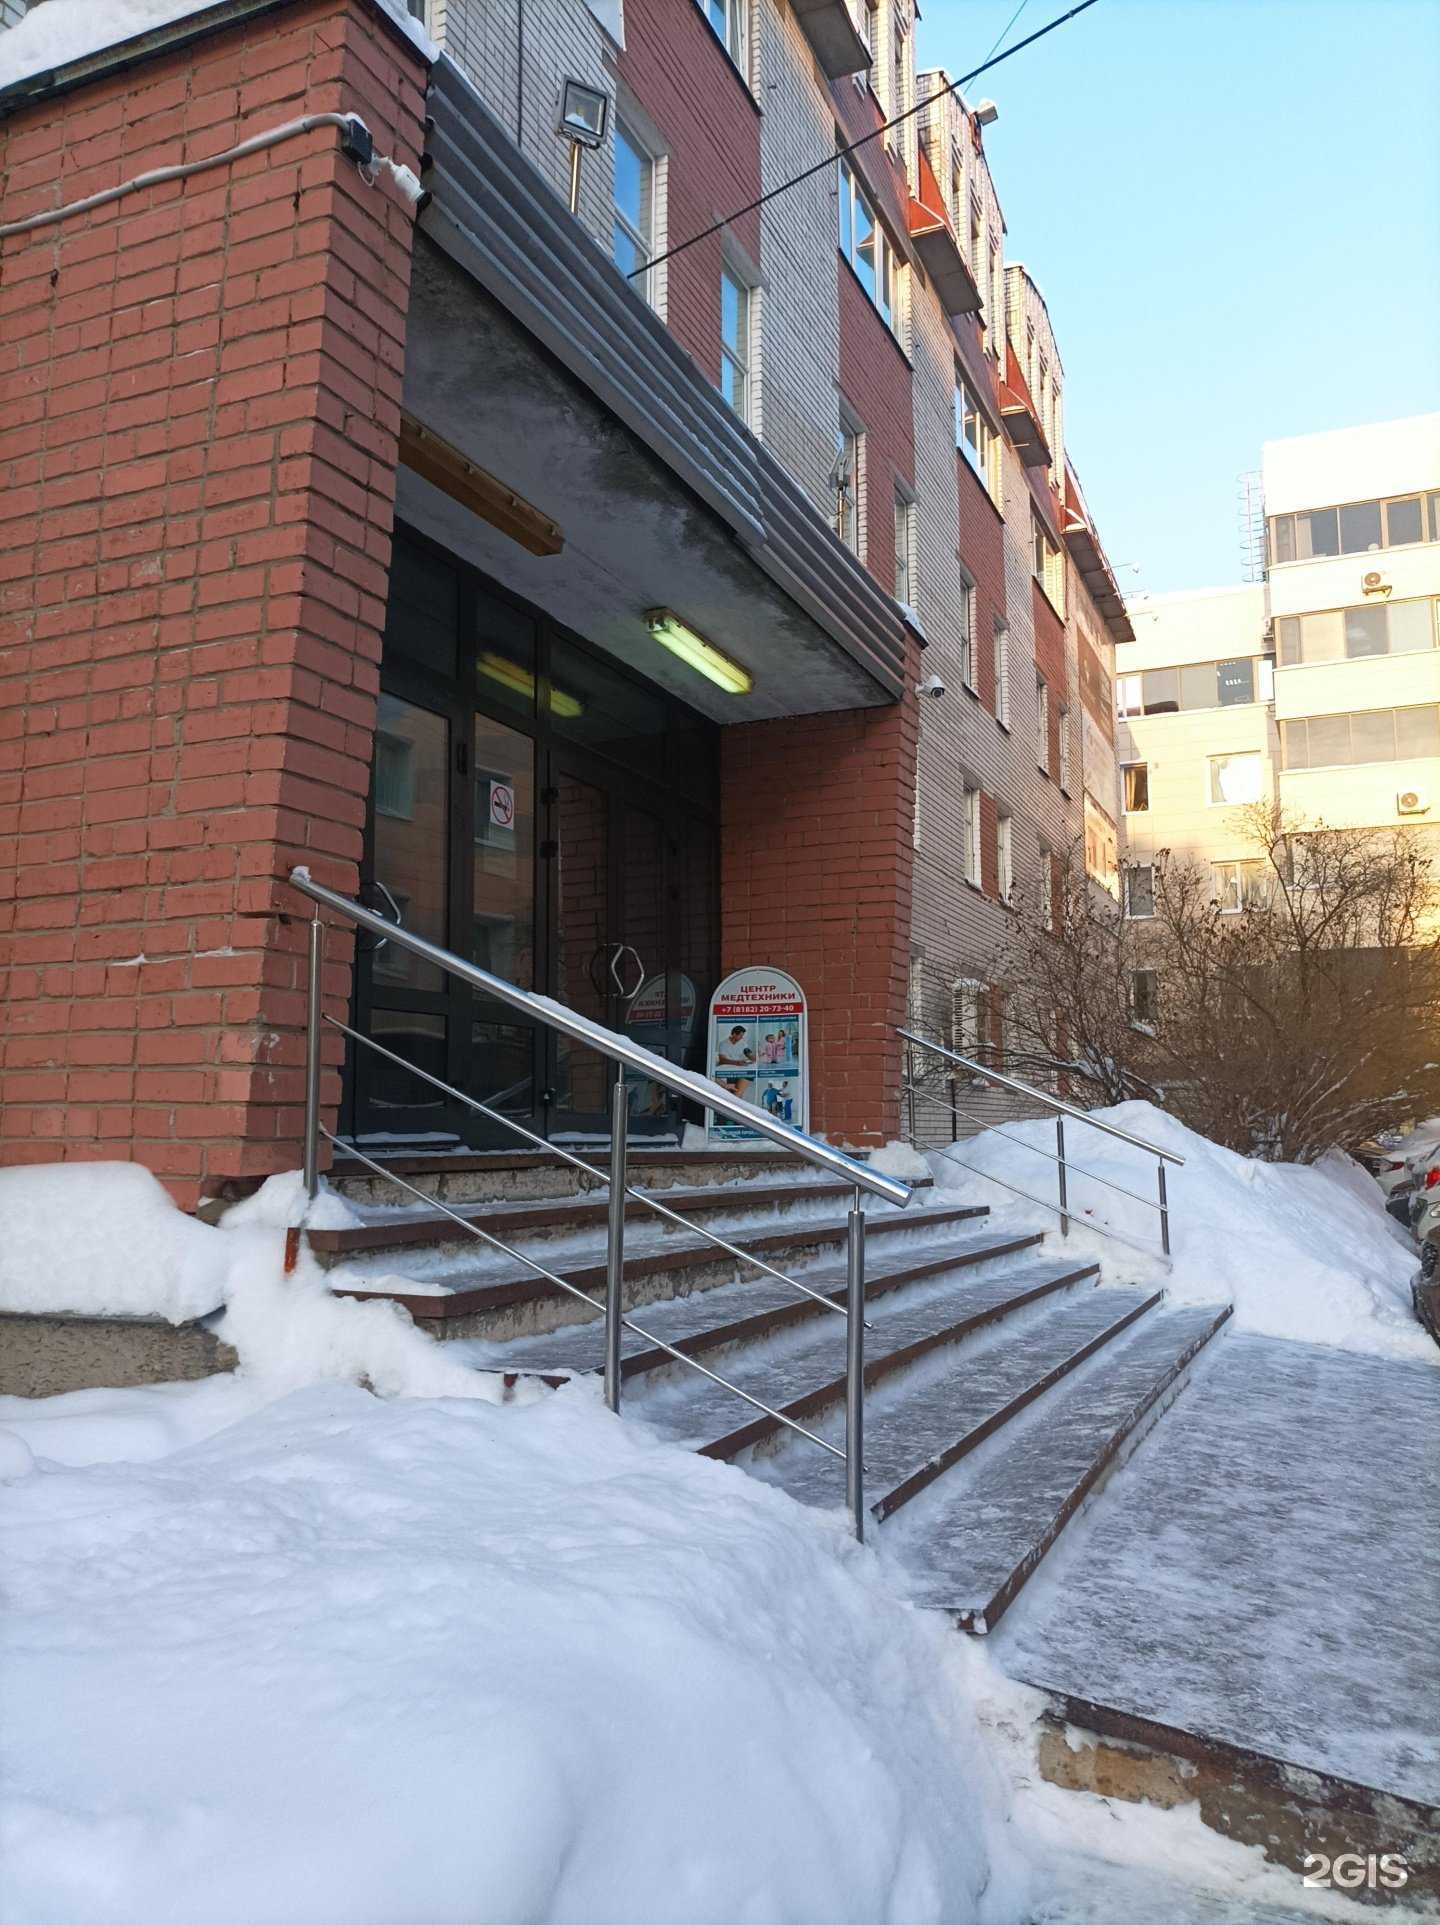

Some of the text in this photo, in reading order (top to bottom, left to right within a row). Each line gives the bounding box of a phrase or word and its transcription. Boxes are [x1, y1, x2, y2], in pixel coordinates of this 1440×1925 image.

[741, 985, 776, 993] ЦЕНТР
[721, 993, 795, 1002] МЕДТЕХНИКИ
[733, 1005, 758, 1013] (8182)
